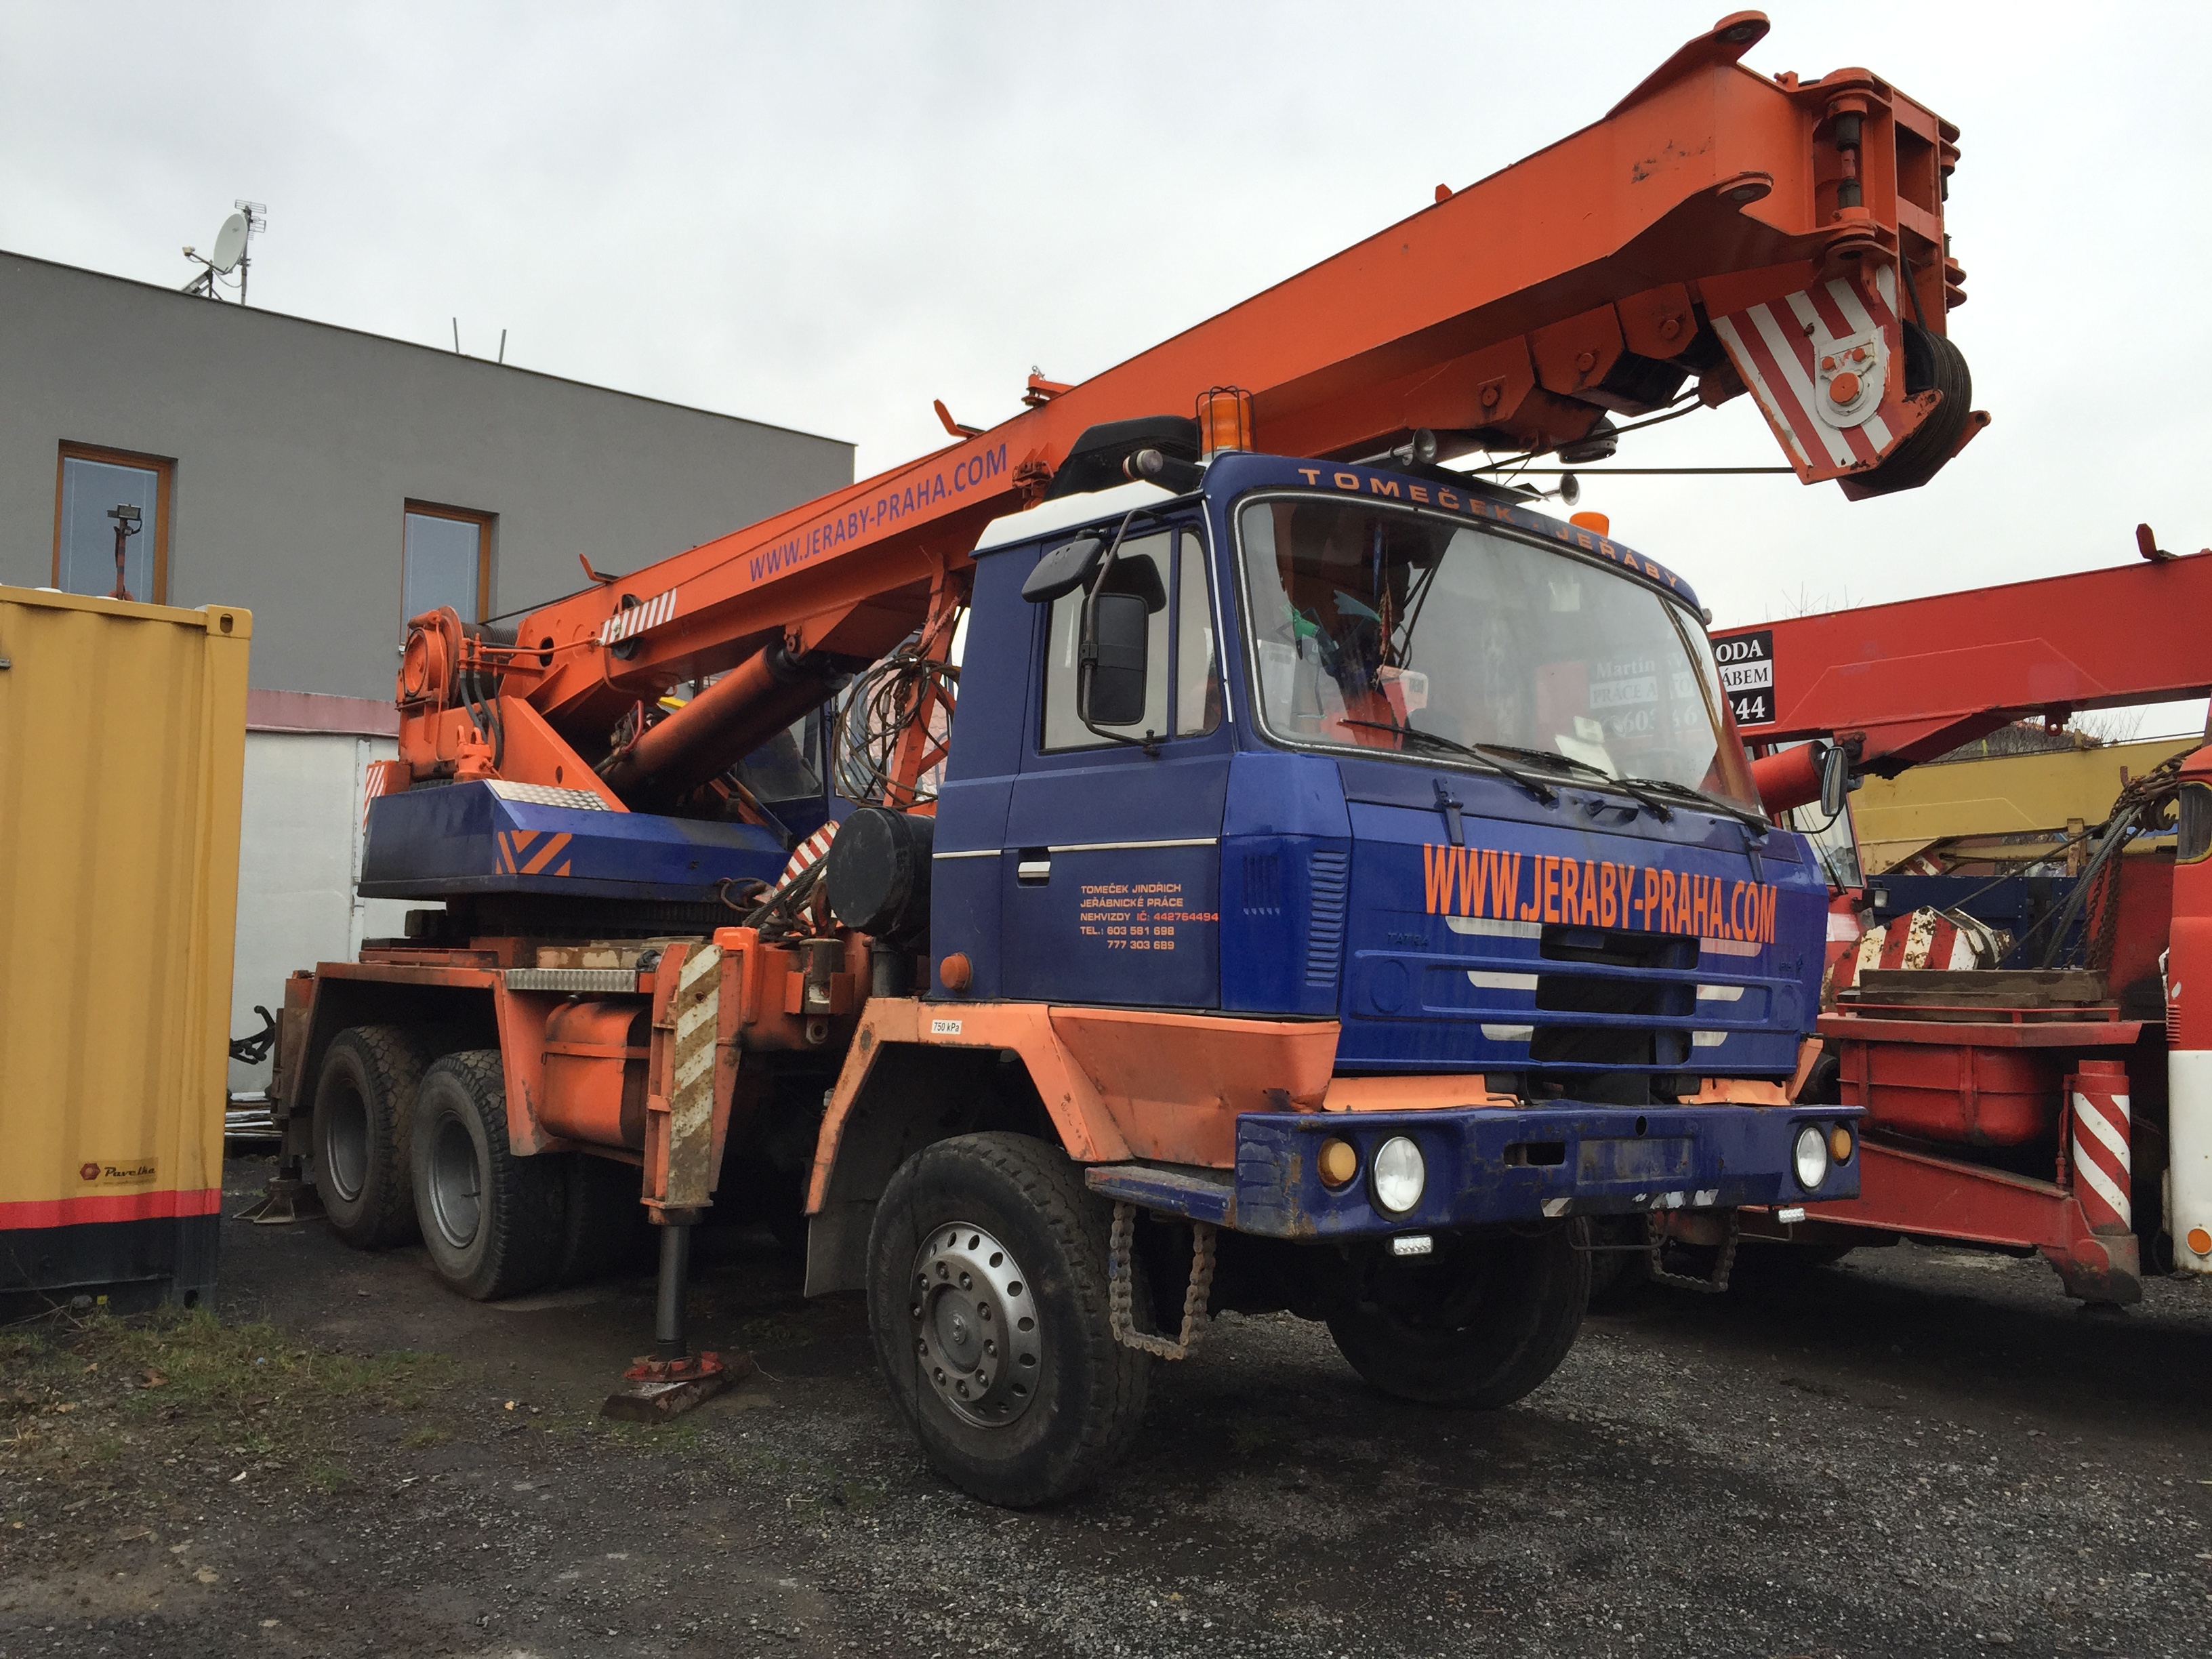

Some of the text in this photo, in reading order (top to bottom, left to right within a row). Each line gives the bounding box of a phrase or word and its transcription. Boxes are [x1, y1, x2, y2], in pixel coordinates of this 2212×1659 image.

[750, 443, 1006, 581] WWW.JERABY-PRAHA.COM
[1298, 468, 1513, 523] TOMEČEK
[1555, 528, 1678, 588] JEŘÁBY
[1081, 882, 1181, 894] TOMEČEK JINDŘICH
[1424, 842, 1777, 944] WWW.JERABY-PRAHA.COM
[1080, 895, 1183, 907] JEŘÁBNICKÉ PRÁCE
[1080, 913, 1130, 922] NEHVIZDY
[1153, 912, 1218, 922] 442764494
[1107, 926, 1126, 935] 603
[1130, 926, 1149, 935] 581
[1153, 926, 1174, 935] 698
[1107, 940, 1174, 949] 777 303 689
[934, 1022, 960, 1032] 750 kPa
